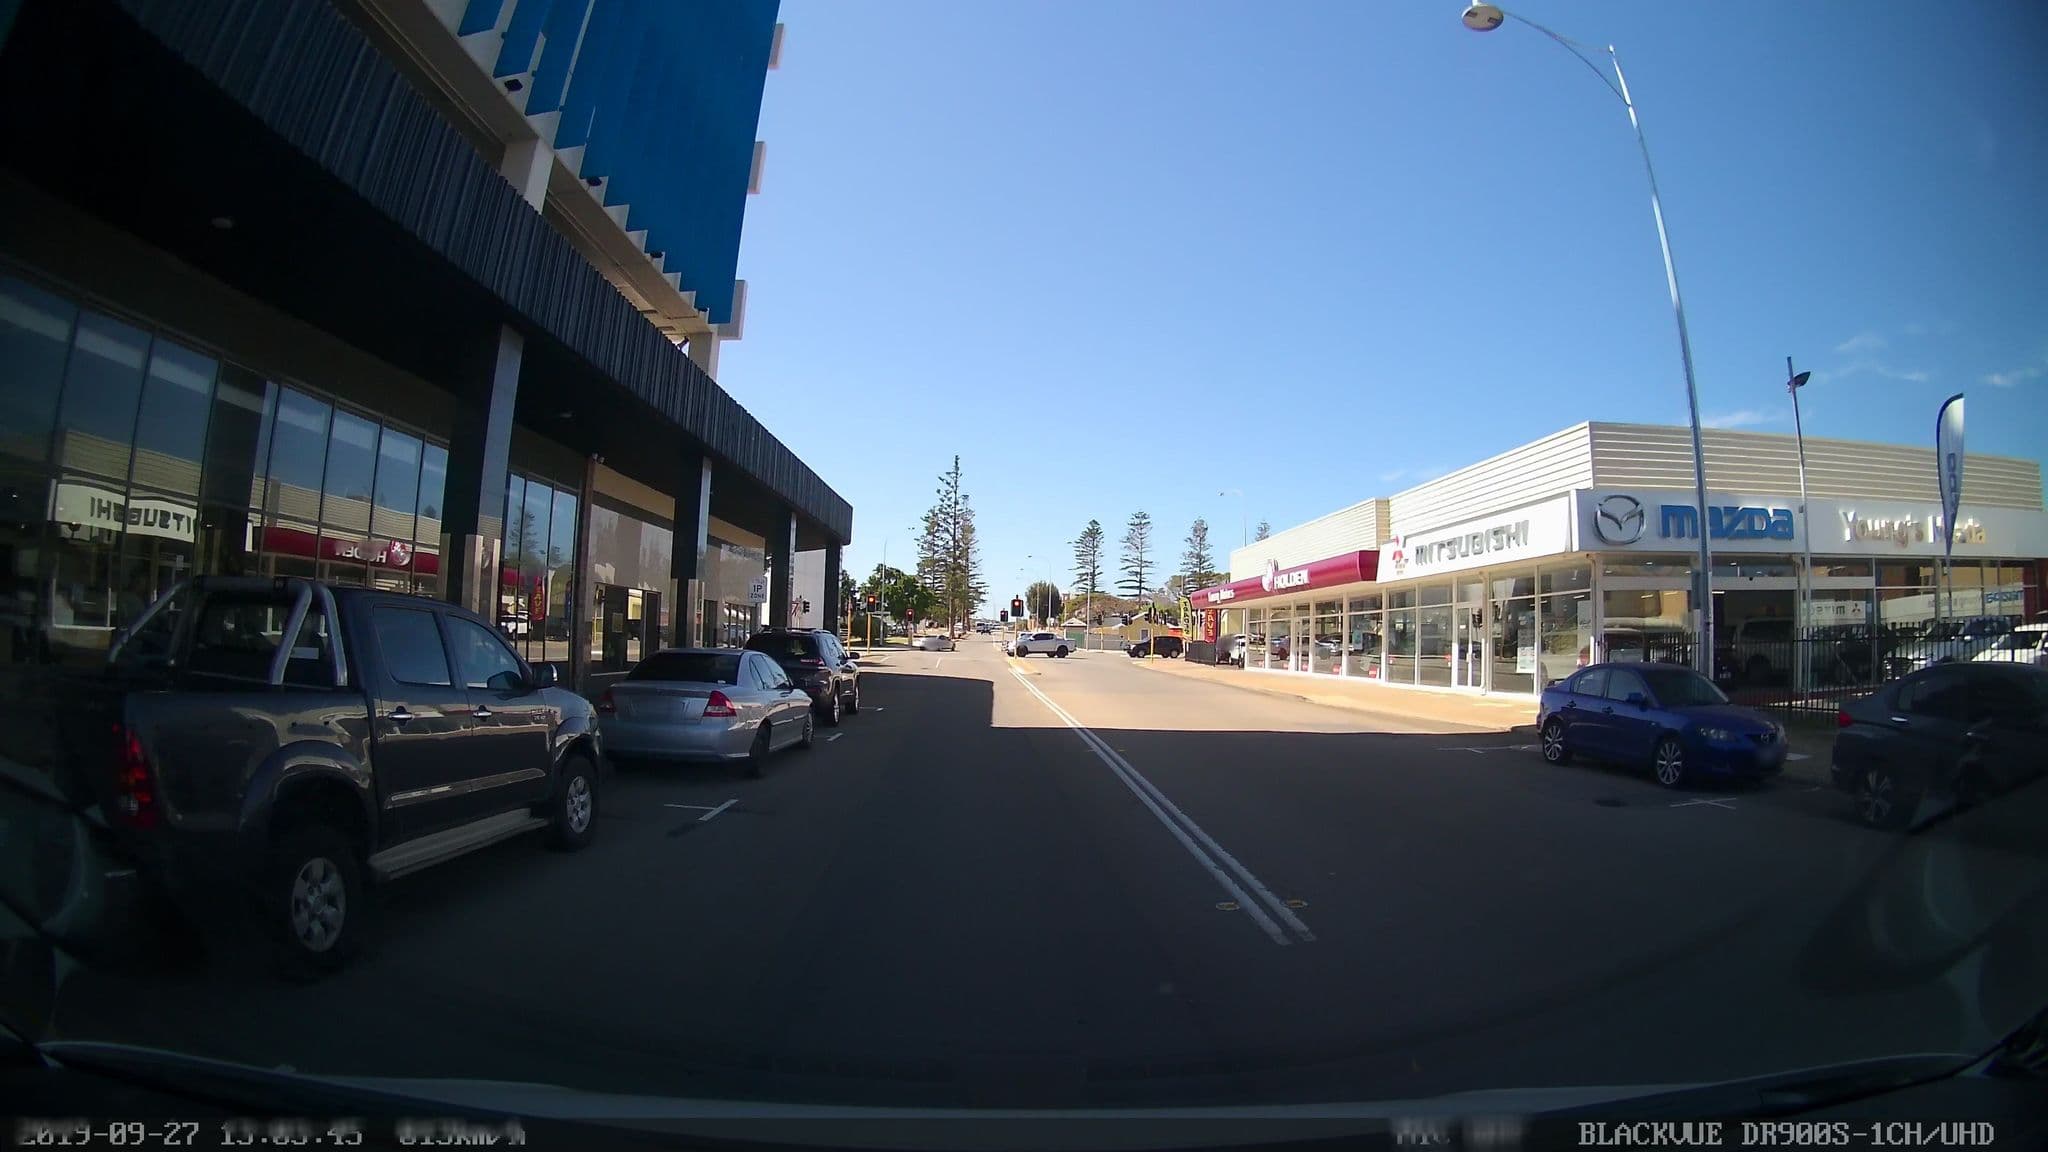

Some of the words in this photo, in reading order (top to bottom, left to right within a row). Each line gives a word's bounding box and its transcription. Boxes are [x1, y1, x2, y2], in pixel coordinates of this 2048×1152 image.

[1415, 519, 1530, 566] MITSUBISHI
[1927, 514, 1986, 545] Mzda
[1273, 569, 1310, 590] HOLDEN
